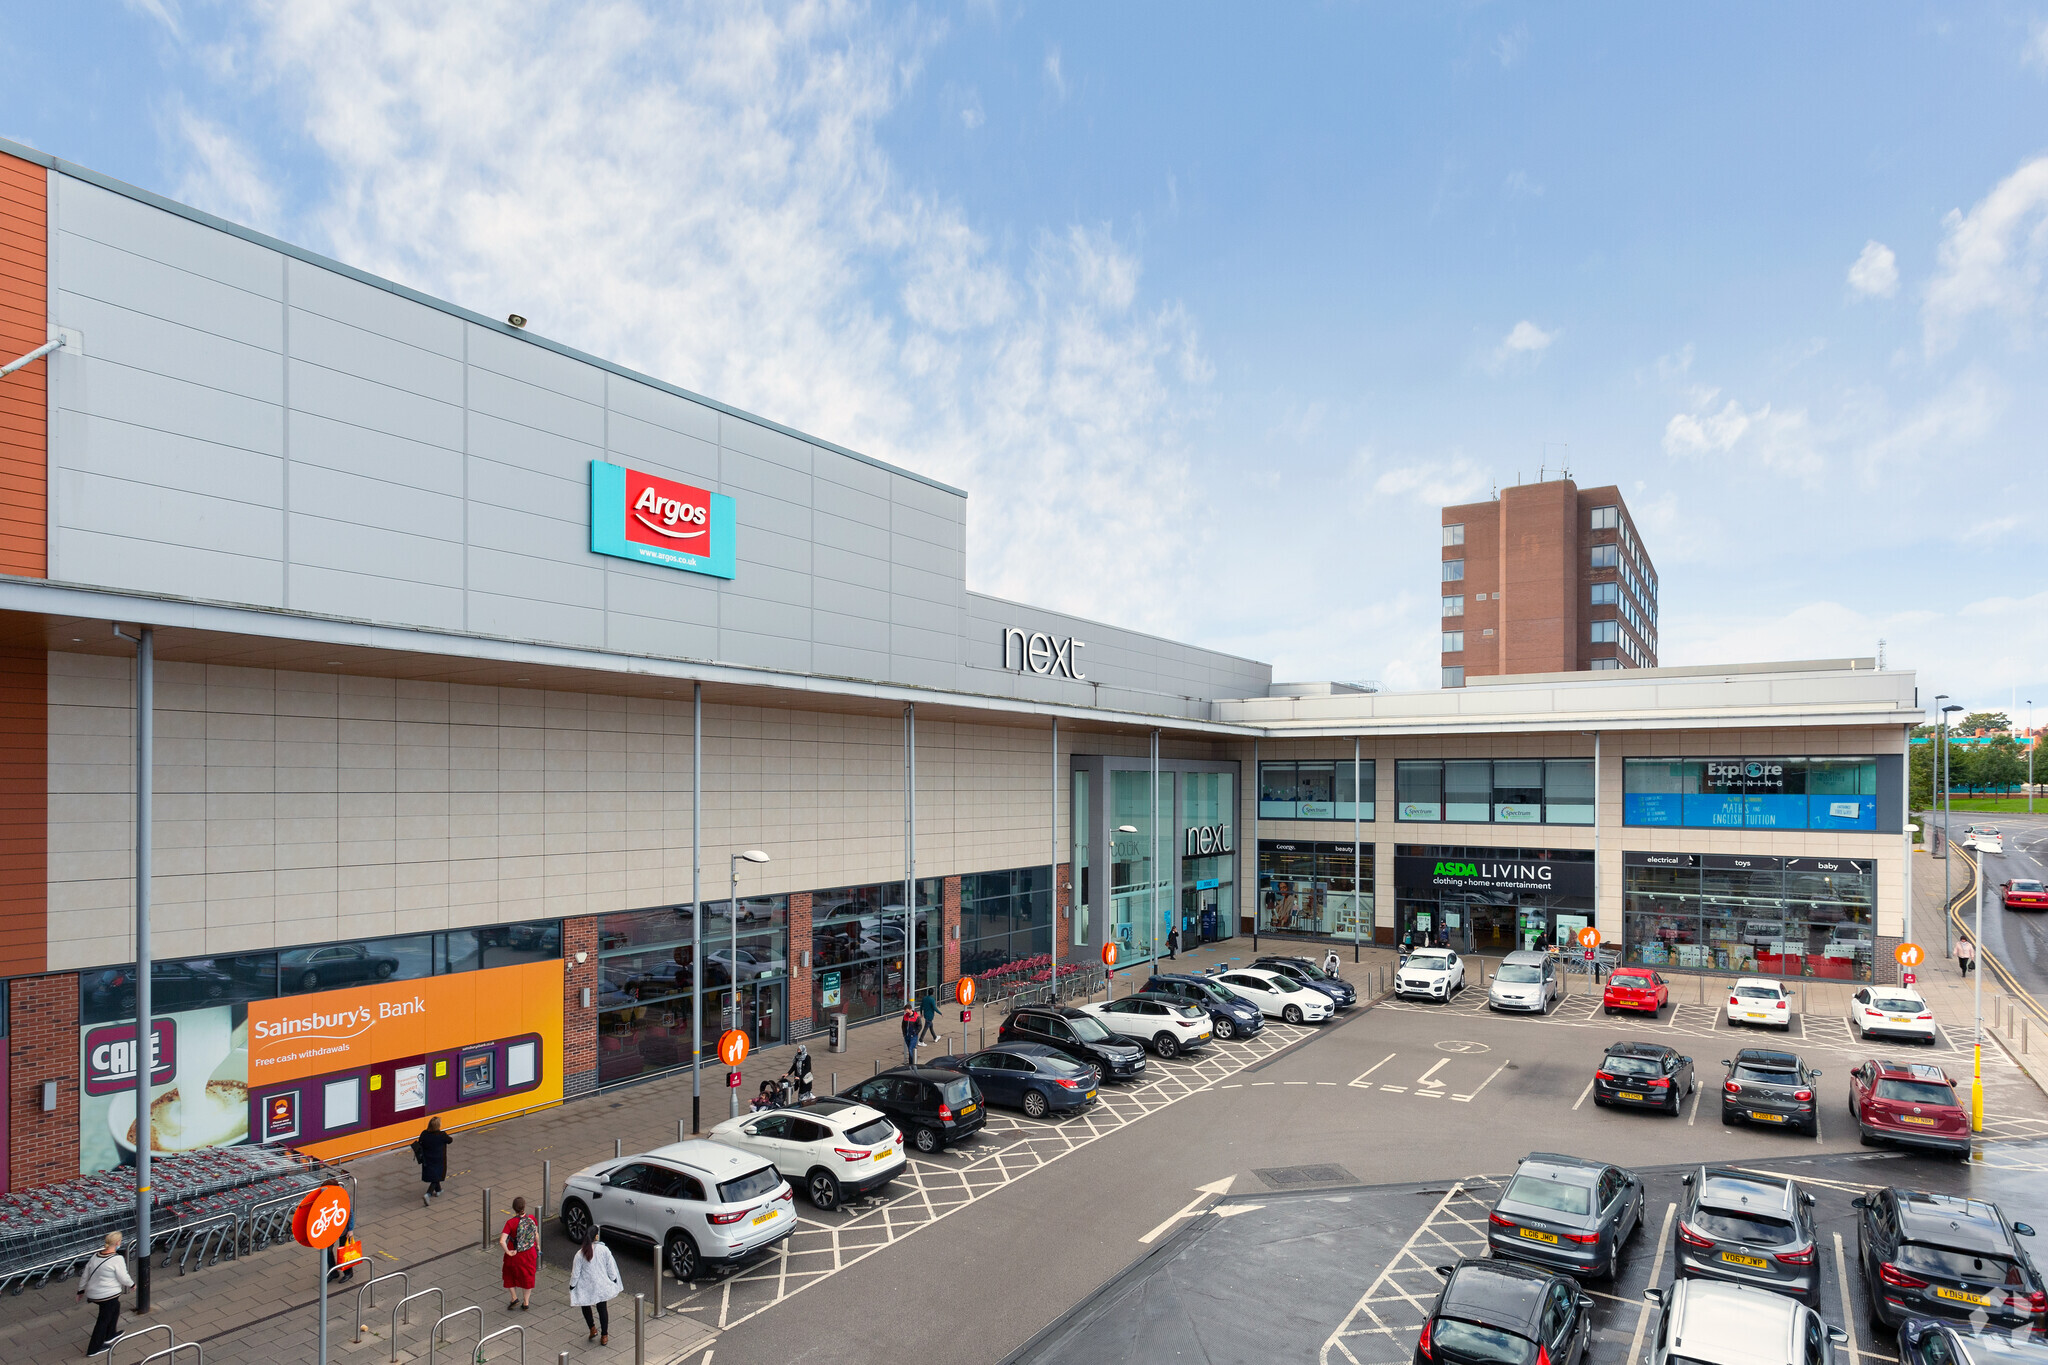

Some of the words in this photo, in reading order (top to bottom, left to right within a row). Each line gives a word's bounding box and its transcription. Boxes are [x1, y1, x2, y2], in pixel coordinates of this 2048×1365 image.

[633, 487, 707, 526] Argos
[639, 548, 697, 567] www.argos.co.uk
[1004, 628, 1086, 680] next
[1712, 814, 1742, 825] ENGLISH
[1746, 814, 1776, 825] TUITION
[1186, 823, 1231, 856] next
[1335, 845, 1354, 853] beauty
[1647, 856, 1679, 864] electrical
[1735, 860, 1751, 868] toys
[1818, 861, 1839, 871] baby
[1433, 862, 1478, 877] ASDA
[1482, 863, 1552, 881] LIVING
[1433, 877, 1463, 887] clothing
[1468, 878, 1490, 887] home
[1495, 880, 1552, 890] entertainment
[255, 1005, 371, 1039] Sainsbury's
[379, 996, 426, 1019] Bank
[255, 1057, 275, 1067] Free
[276, 1053, 297, 1064] cash
[298, 1043, 350, 1059] withdrawals
[1524, 1229, 1538, 1238] LG16
[1725, 1253, 1745, 1263] VO67
[1943, 1288, 1963, 1300] YD19
[1966, 1294, 1984, 1304] AGT
